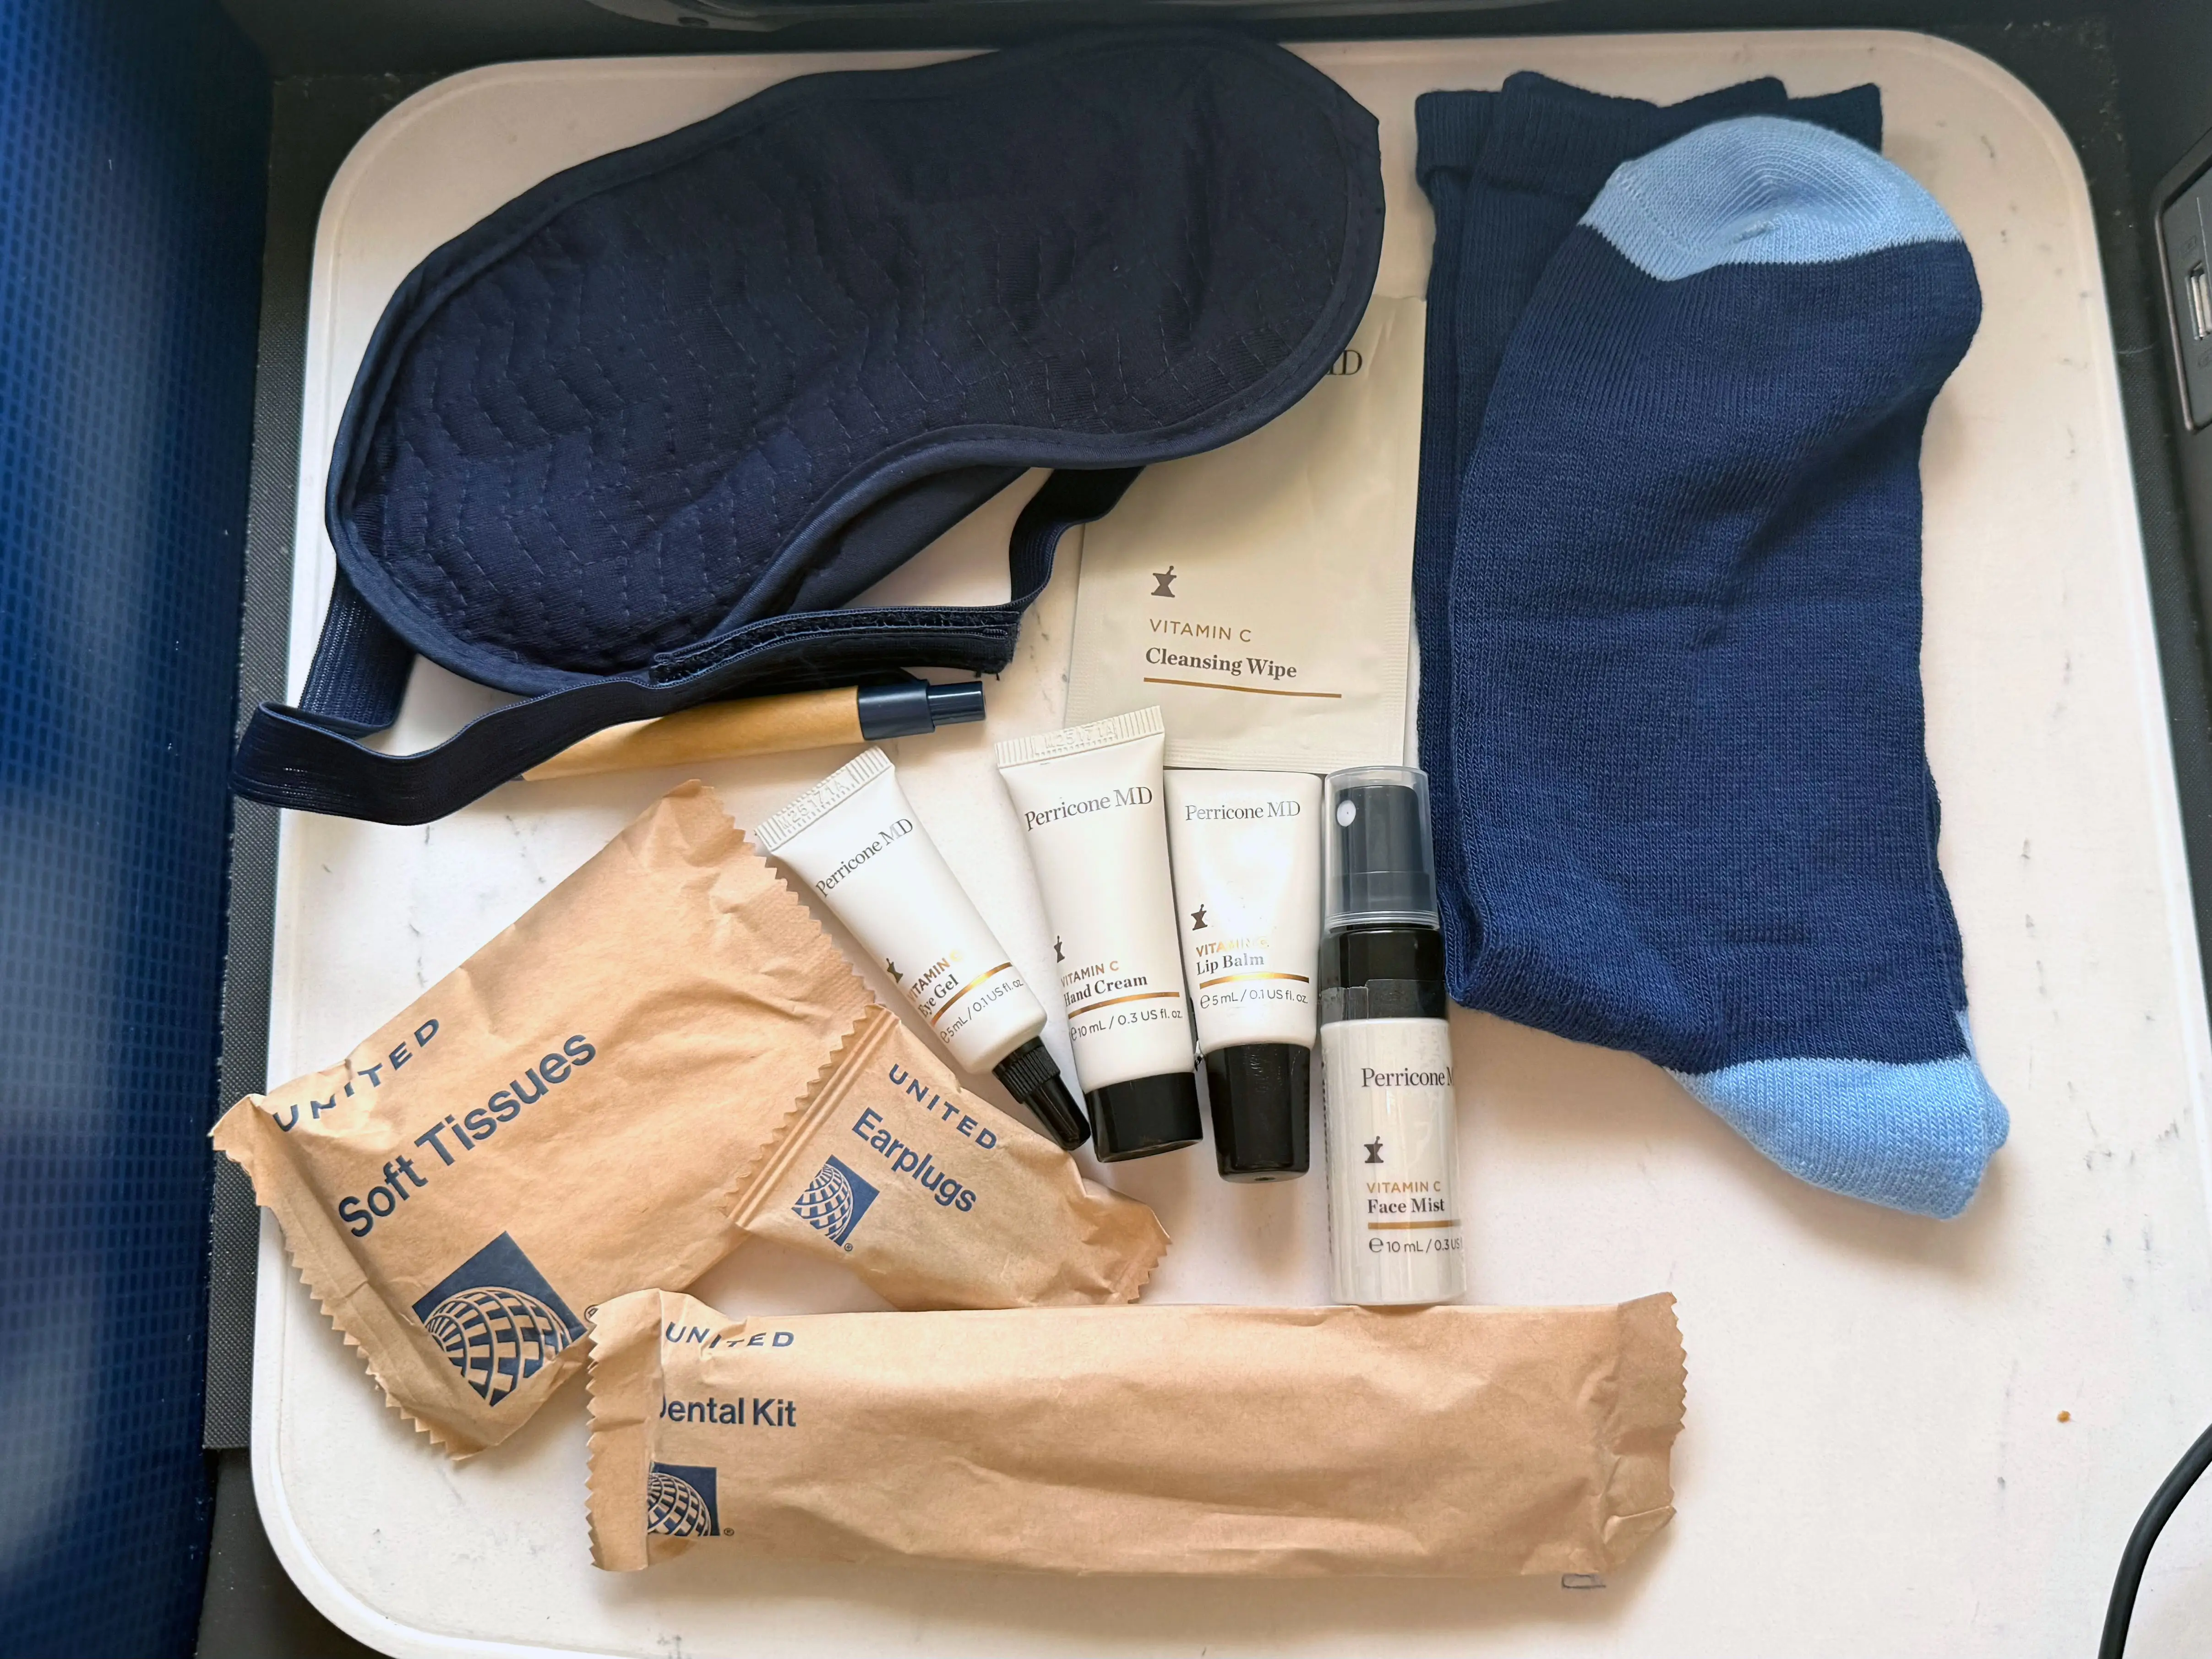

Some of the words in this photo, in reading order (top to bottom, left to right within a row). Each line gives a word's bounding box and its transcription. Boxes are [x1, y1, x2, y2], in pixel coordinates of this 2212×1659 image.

[1328, 349, 1362, 375] D
[1150, 618, 1231, 641] VITAMIN
[1239, 629, 1252, 642] C
[1146, 647, 1242, 676] Cleansing
[1246, 657, 1297, 680] Wipe
[1024, 796, 1111, 832] Perricone
[1113, 786, 1152, 807] MD
[1185, 805, 1264, 821] Perricone
[1267, 800, 1301, 817] MD
[815, 841, 883, 898] Perricone
[877, 818, 913, 846] MD
[1195, 938, 1254, 957] VITAMIN
[1060, 963, 1105, 988] VITAMIN
[1109, 960, 1119, 971] C
[1196, 959, 1219, 976] Lip
[1222, 953, 1264, 968] Balm
[907, 957, 951, 1002] VITAMIN
[1063, 984, 1092, 1007] Hand
[1094, 976, 1148, 994] Cream
[918, 996, 937, 1018] Eye
[934, 974, 960, 998] Gel
[973, 997, 988, 1012] 0.1
[986, 987, 1004, 1001] US
[1249, 990, 1264, 999] 0.1
[1267, 989, 1283, 1000] US
[1117, 1012, 1138, 1025] 0.3
[1140, 1009, 1158, 1021] US
[272, 1018, 440, 1132] UNITED
[1361, 1067, 1445, 1088] Perricone
[888, 1063, 997, 1149] UNITED
[338, 1154, 429, 1237] Soft
[414, 1034, 596, 1166] Tissues
[851, 1106, 977, 1212] Earplugs
[1366, 1181, 1428, 1193] VITAMIN
[1433, 1180, 1441, 1192] C
[1367, 1198, 1406, 1213] Face
[1410, 1197, 1445, 1213] Mist
[1404, 1240, 1423, 1252] mL
[1434, 1239, 1450, 1251] 0.3
[665, 1322, 795, 1349] UNITED
[753, 1398, 796, 1427] Kit
